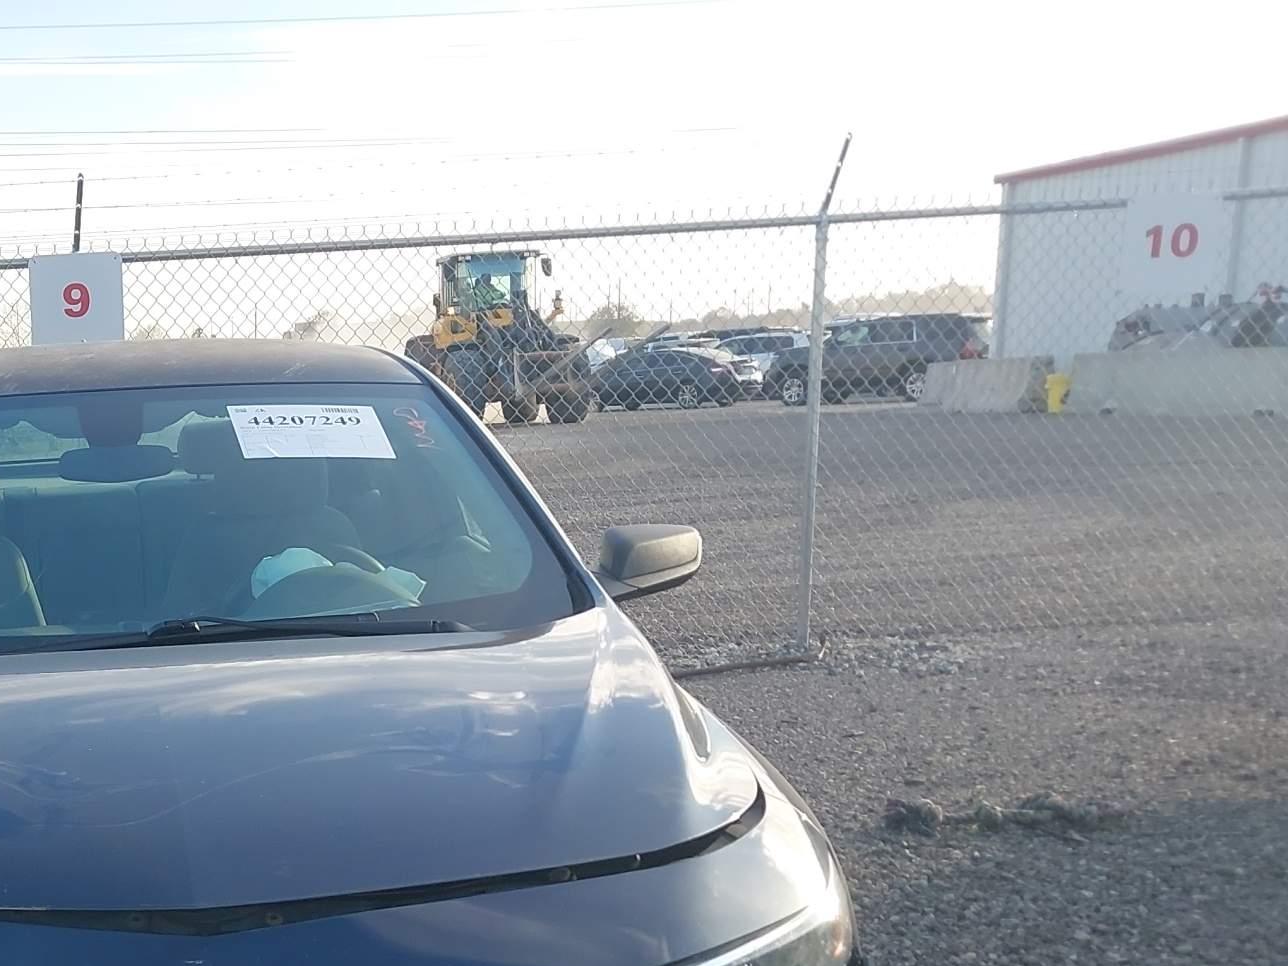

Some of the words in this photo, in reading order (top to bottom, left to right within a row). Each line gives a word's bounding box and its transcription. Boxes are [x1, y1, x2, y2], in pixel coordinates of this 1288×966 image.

[1145, 222, 1199, 258] 10
[62, 282, 91, 318] 9
[247, 415, 361, 426] 44207249
